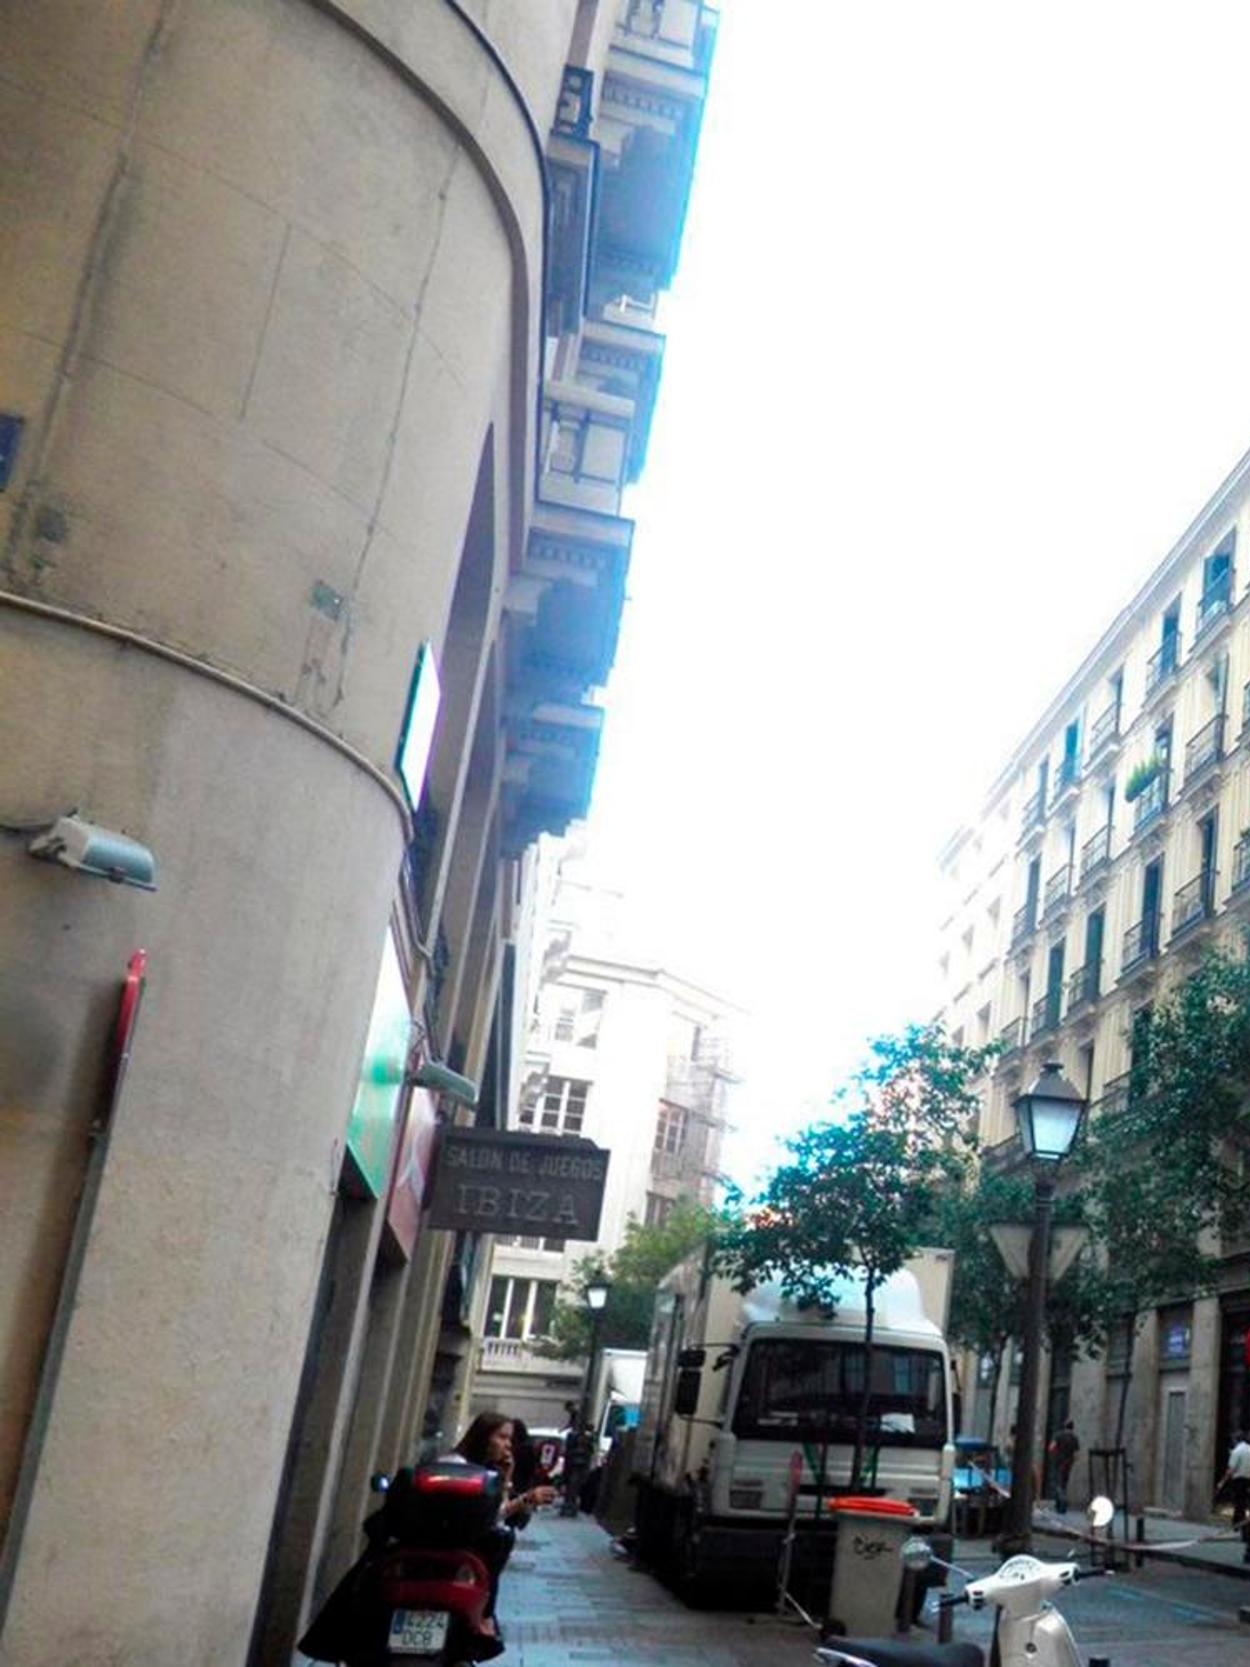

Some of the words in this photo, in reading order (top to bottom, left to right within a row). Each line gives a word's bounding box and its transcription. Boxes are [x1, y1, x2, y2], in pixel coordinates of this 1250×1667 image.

[509, 1150, 531, 1174] DE
[538, 1155, 603, 1182] JUEGOS
[454, 1184, 580, 1225] IBIZA
